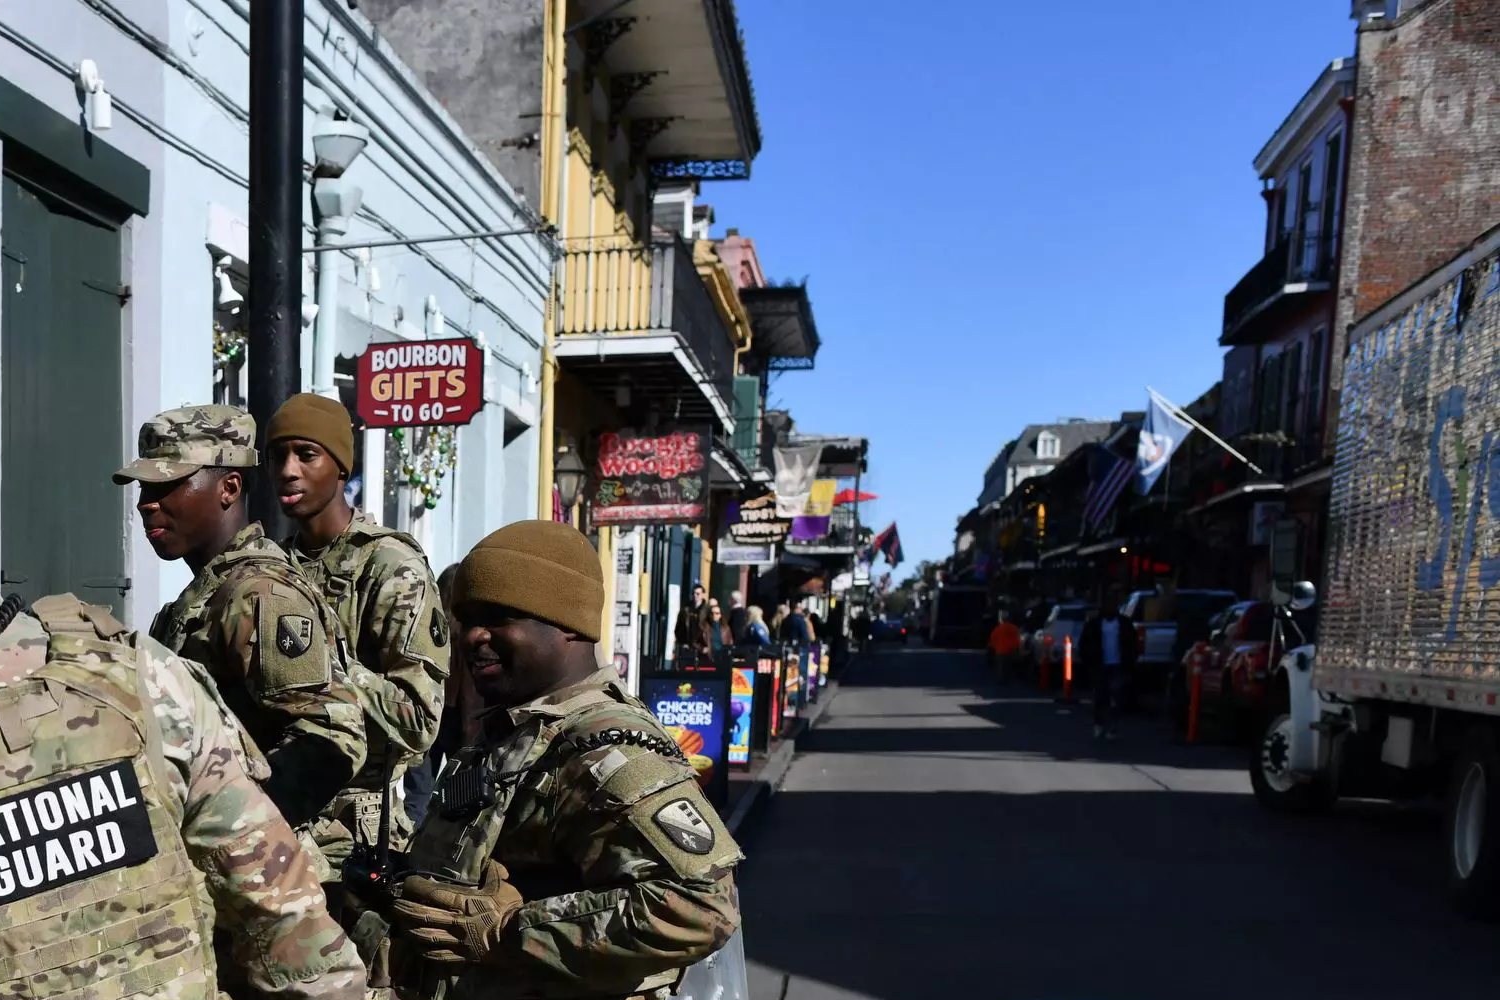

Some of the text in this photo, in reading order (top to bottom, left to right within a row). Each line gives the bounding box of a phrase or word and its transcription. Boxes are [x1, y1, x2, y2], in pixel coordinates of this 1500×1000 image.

[371, 344, 467, 372] BOURBON
[370, 369, 466, 401] GIFTS
[391, 402, 444, 422] TO GO
[656, 701, 713, 713] CHICKEN
[657, 712, 712, 726] TENDERS
